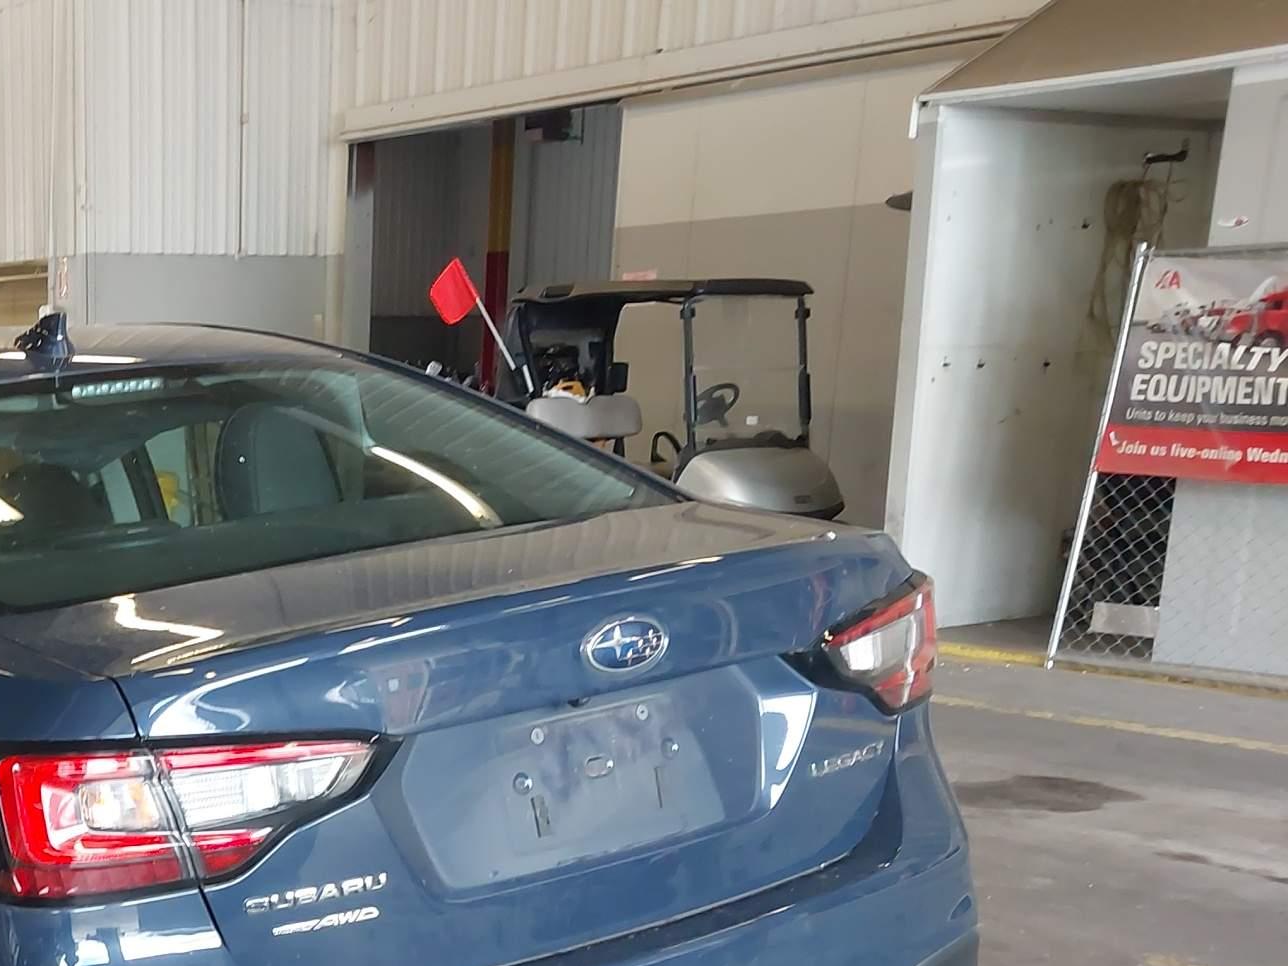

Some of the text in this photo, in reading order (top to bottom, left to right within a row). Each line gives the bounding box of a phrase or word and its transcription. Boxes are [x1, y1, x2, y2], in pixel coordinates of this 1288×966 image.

[1137, 340, 1288, 373] SPECIALTY
[1130, 373, 1288, 406] EQUIPMENT
[1154, 409, 1167, 422] to
[1168, 410, 1195, 425] keep
[1116, 440, 1147, 455] Join
[1150, 443, 1168, 457] us
[811, 739, 885, 778] LEGACY
[242, 871, 388, 914] SUBARU
[312, 905, 381, 931] AWD
